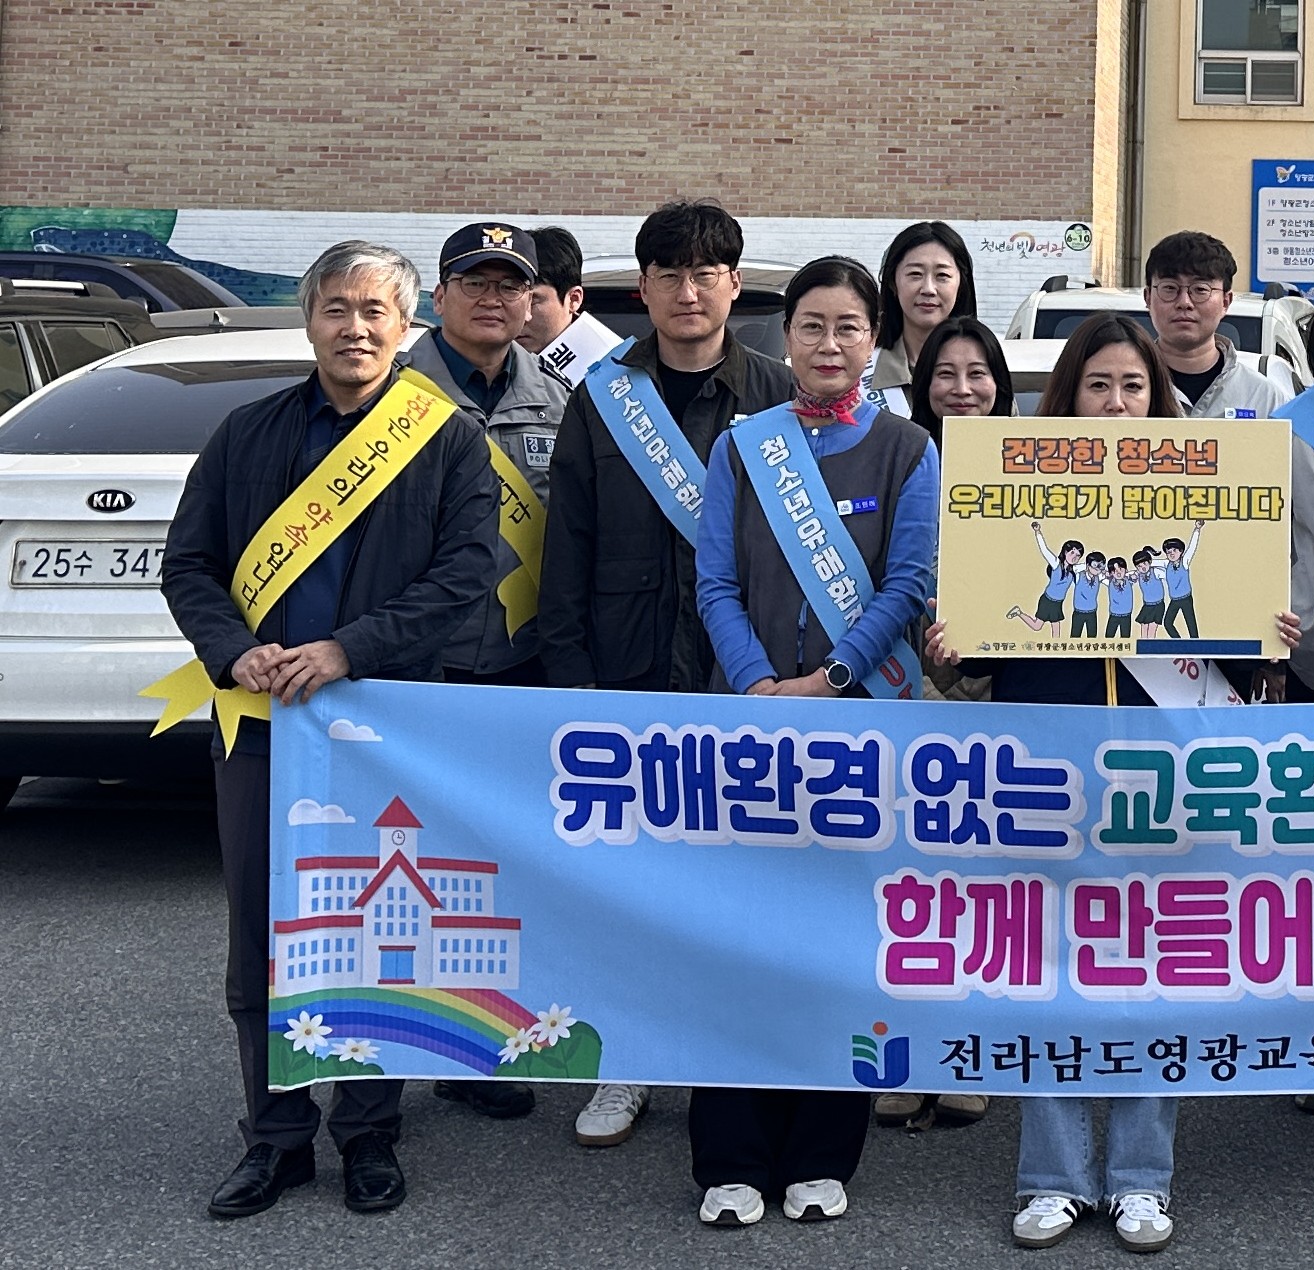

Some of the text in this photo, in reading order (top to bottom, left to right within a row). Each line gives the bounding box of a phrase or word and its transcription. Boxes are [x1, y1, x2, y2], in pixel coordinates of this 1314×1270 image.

[326, 440, 389, 507] 우리의
[1001, 437, 1219, 476] 건강한 청소년
[93, 493, 126, 508] KIA
[948, 484, 1285, 521] 우리사회가 밝아집니다
[32, 548, 93, 578] 25수
[241, 502, 334, 611] 약속입니다
[556, 729, 883, 841] 유해환경
[910, 732, 1073, 849] 없는
[881, 873, 1045, 987] 함께
